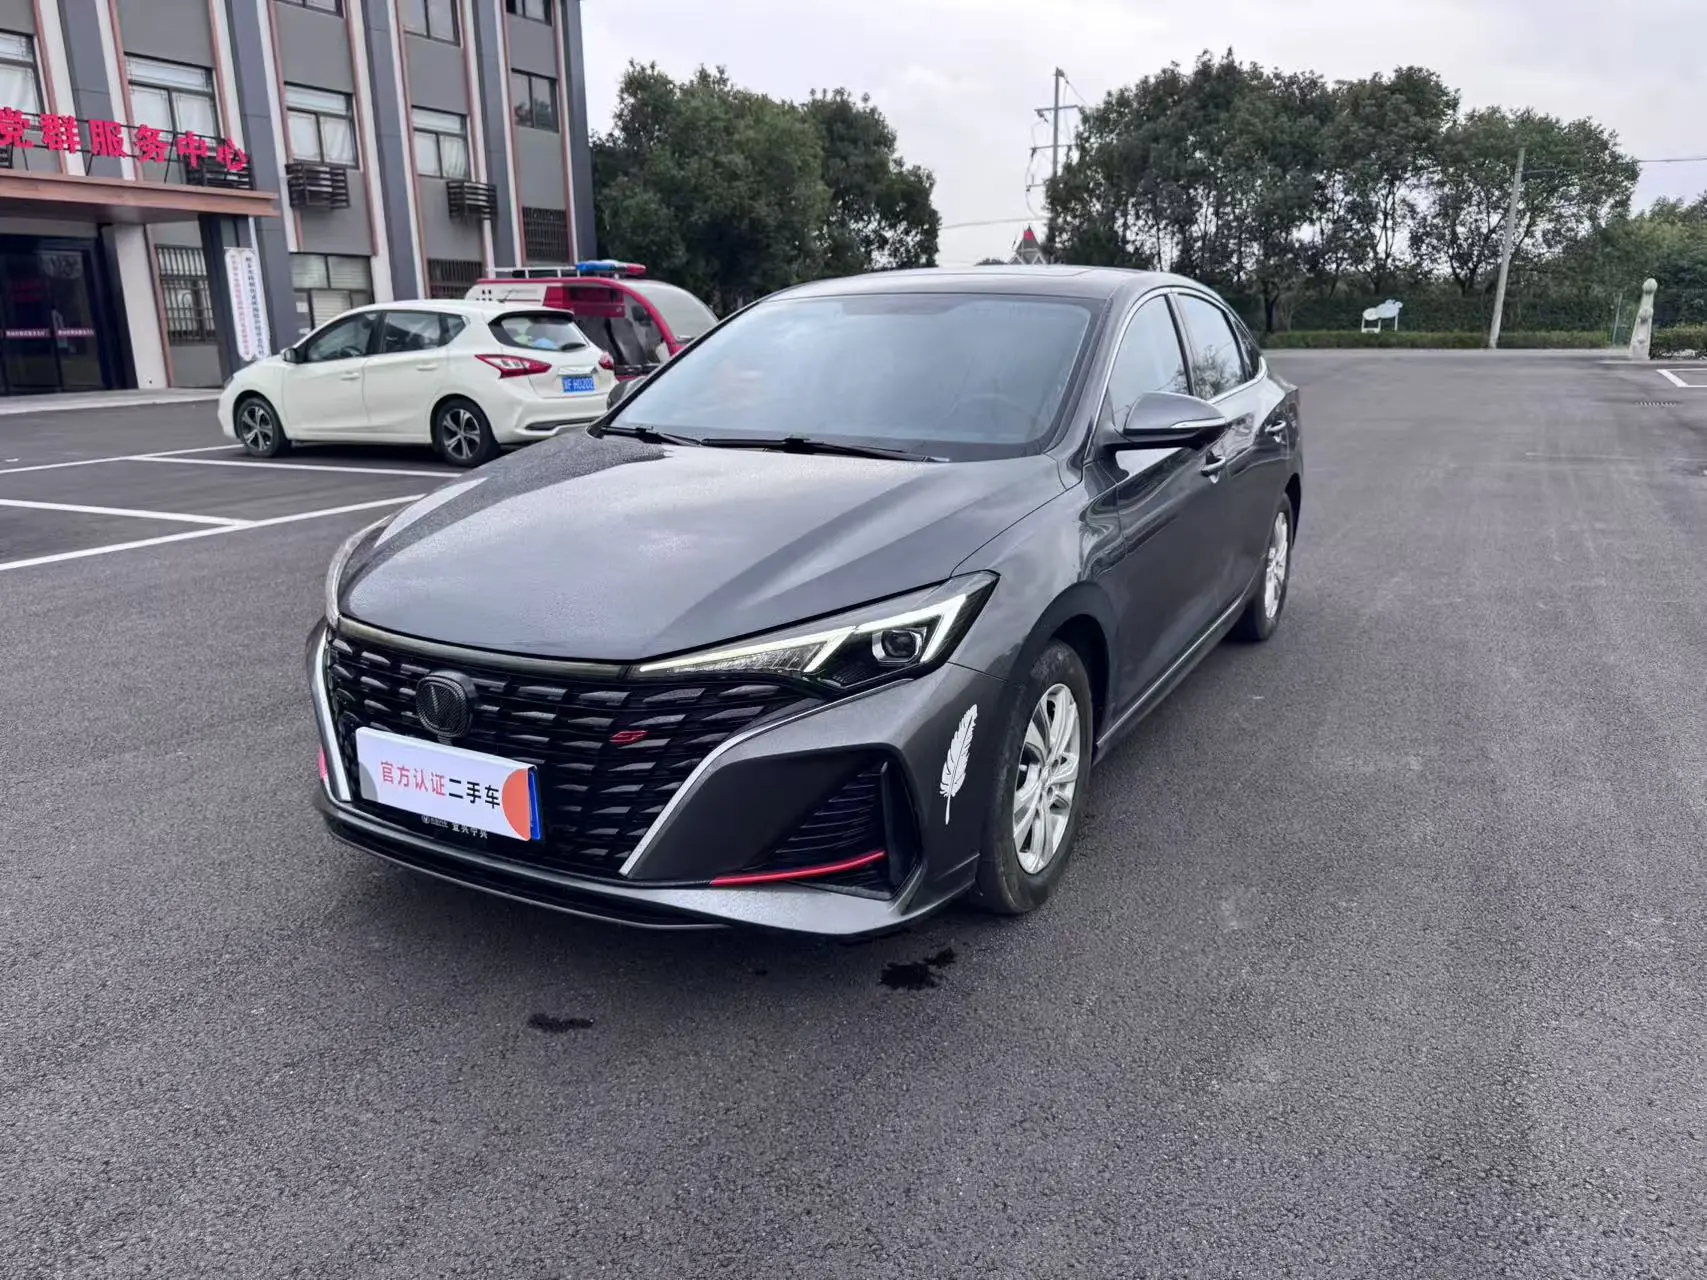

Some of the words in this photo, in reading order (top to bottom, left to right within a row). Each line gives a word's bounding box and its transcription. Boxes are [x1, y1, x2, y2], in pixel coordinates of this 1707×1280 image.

[0, 107, 248, 171] 党群服务中心
[380, 760, 500, 809] 官方认证二手车
